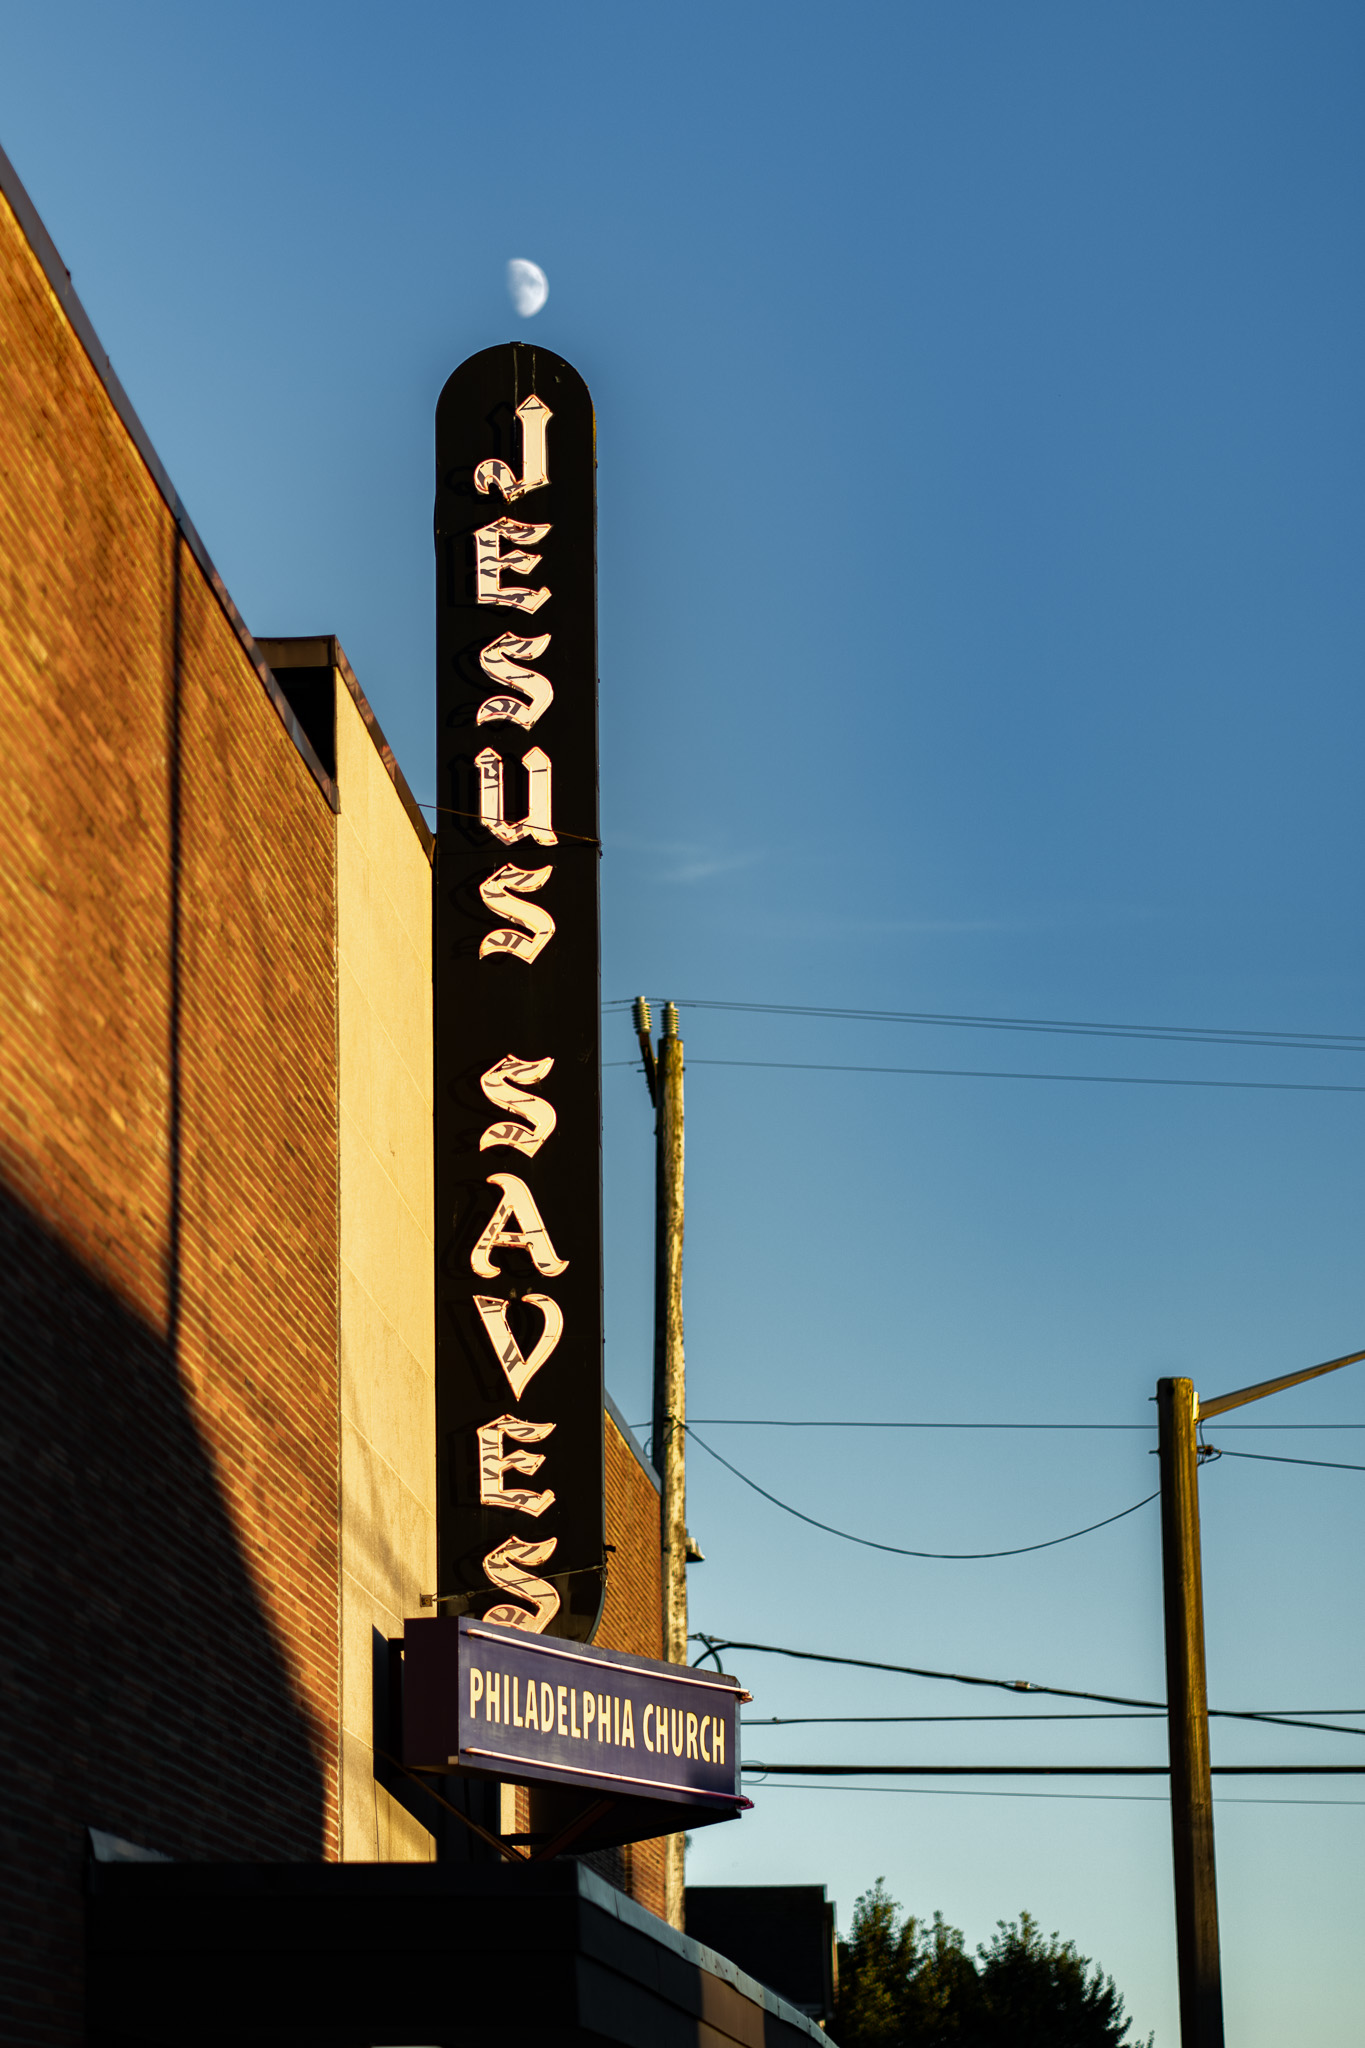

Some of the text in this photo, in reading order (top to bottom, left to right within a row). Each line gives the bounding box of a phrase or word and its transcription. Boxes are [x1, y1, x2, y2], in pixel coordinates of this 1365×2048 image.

[470, 394, 570, 1634] JESUS SAVES
[469, 1667, 725, 1765] PHILADELPHIA CHURCH
